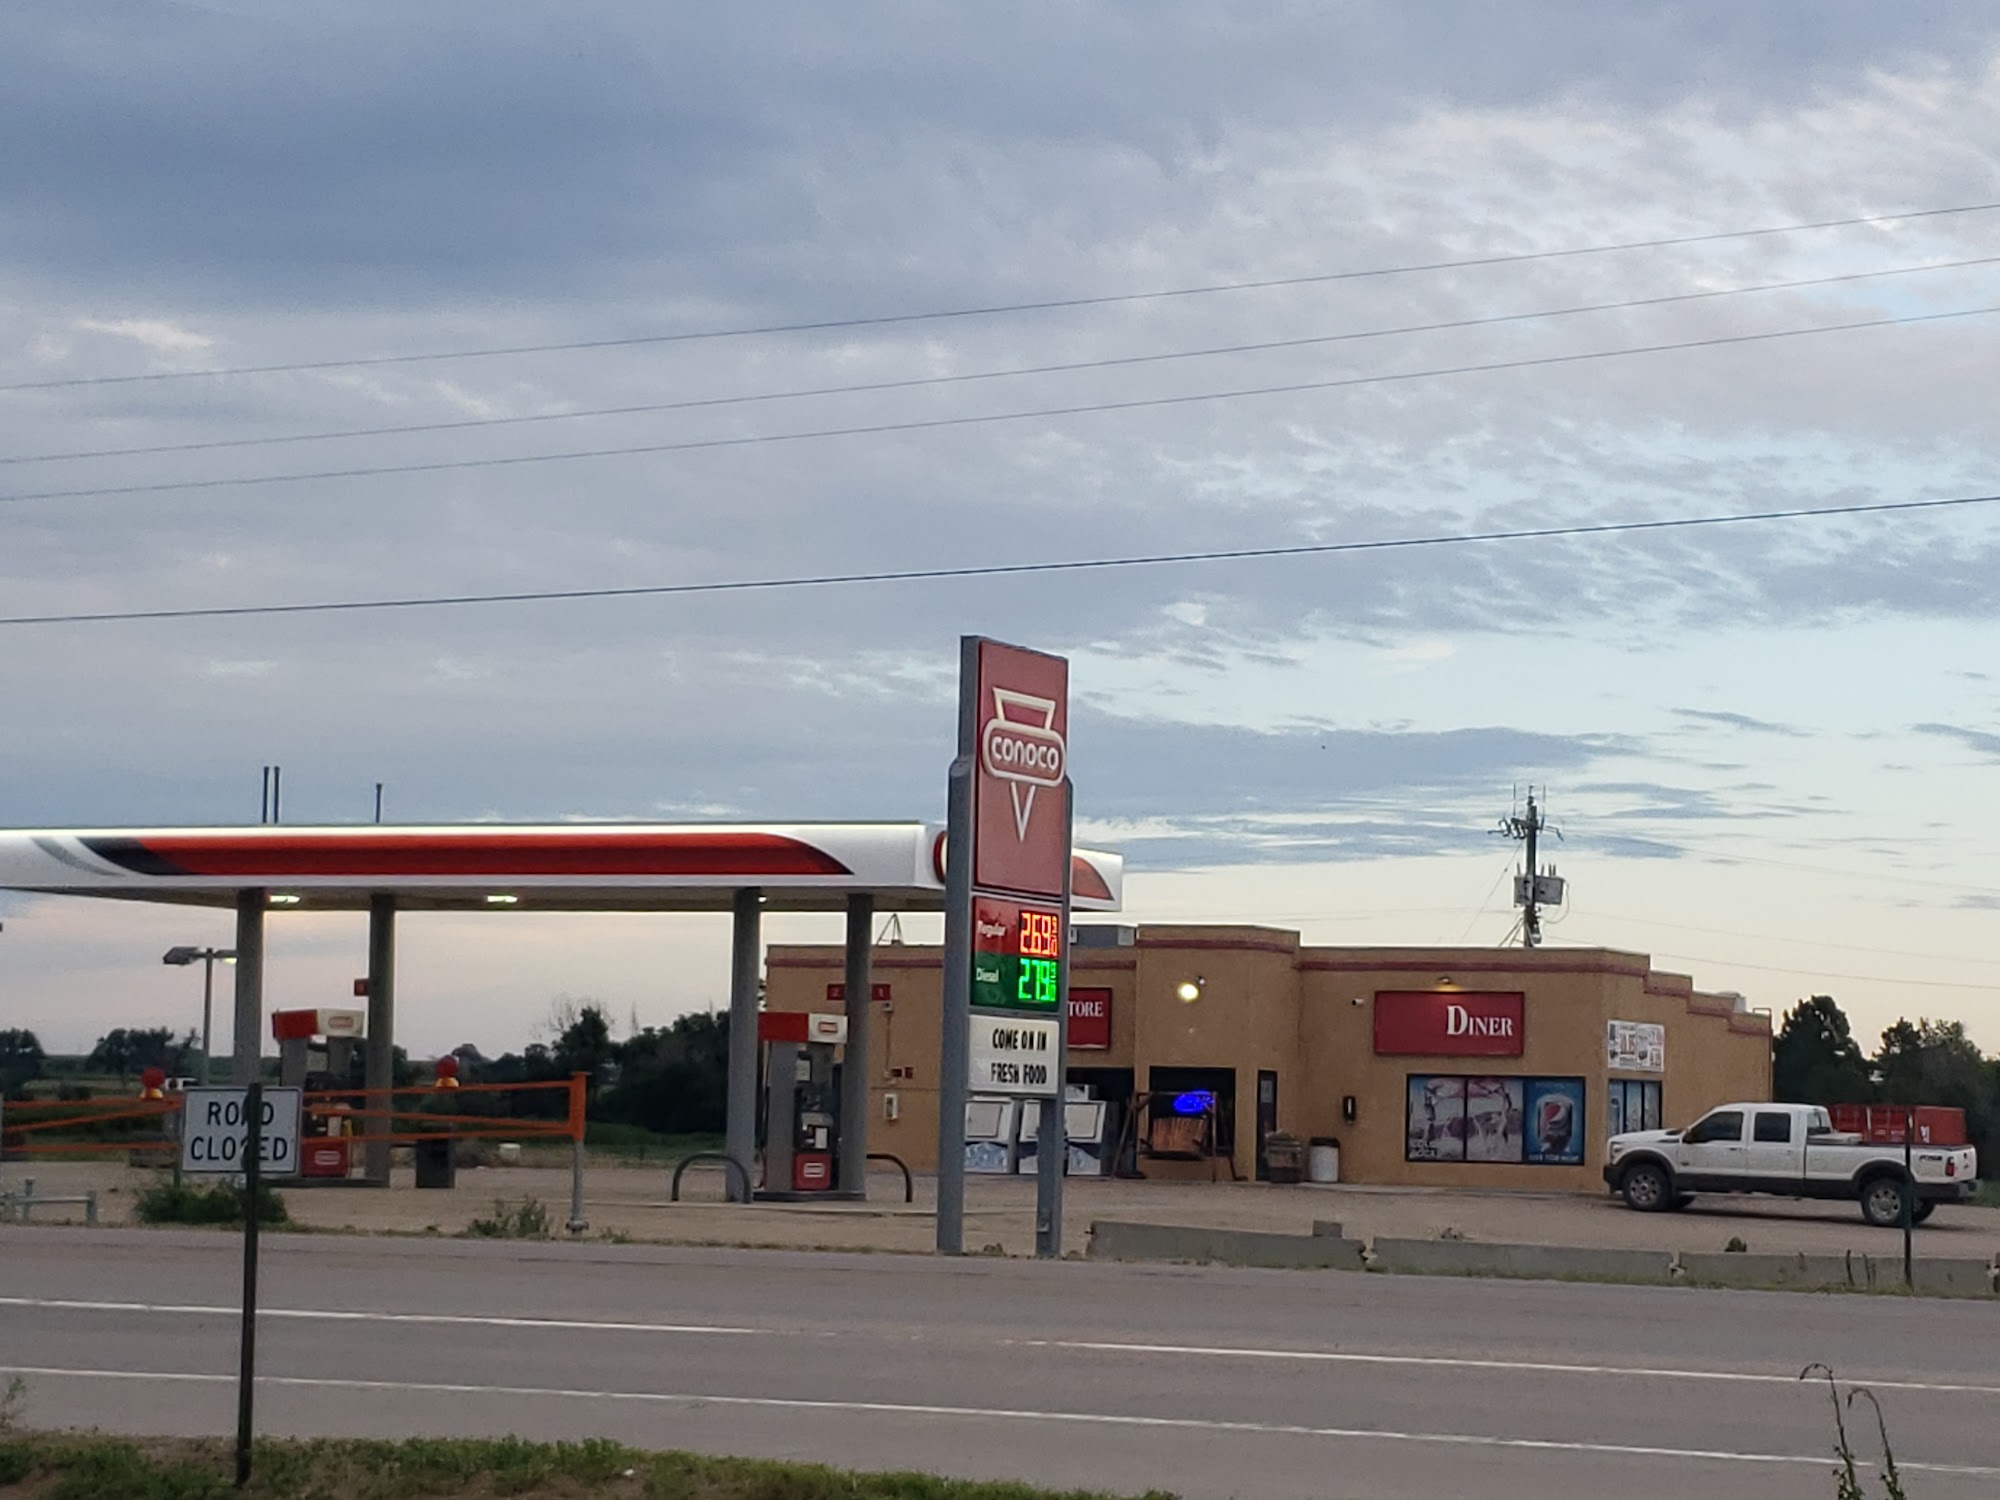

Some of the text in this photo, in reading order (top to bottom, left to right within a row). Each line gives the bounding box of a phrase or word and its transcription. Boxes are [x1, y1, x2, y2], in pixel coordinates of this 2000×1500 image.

[976, 967, 999, 983] Diesel
[1067, 1001, 1104, 1017] TORE
[992, 1028, 1047, 1051] COME ON IN
[991, 1063, 1047, 1085] FRESH FOOD
[191, 1136, 288, 1160] CLOED
